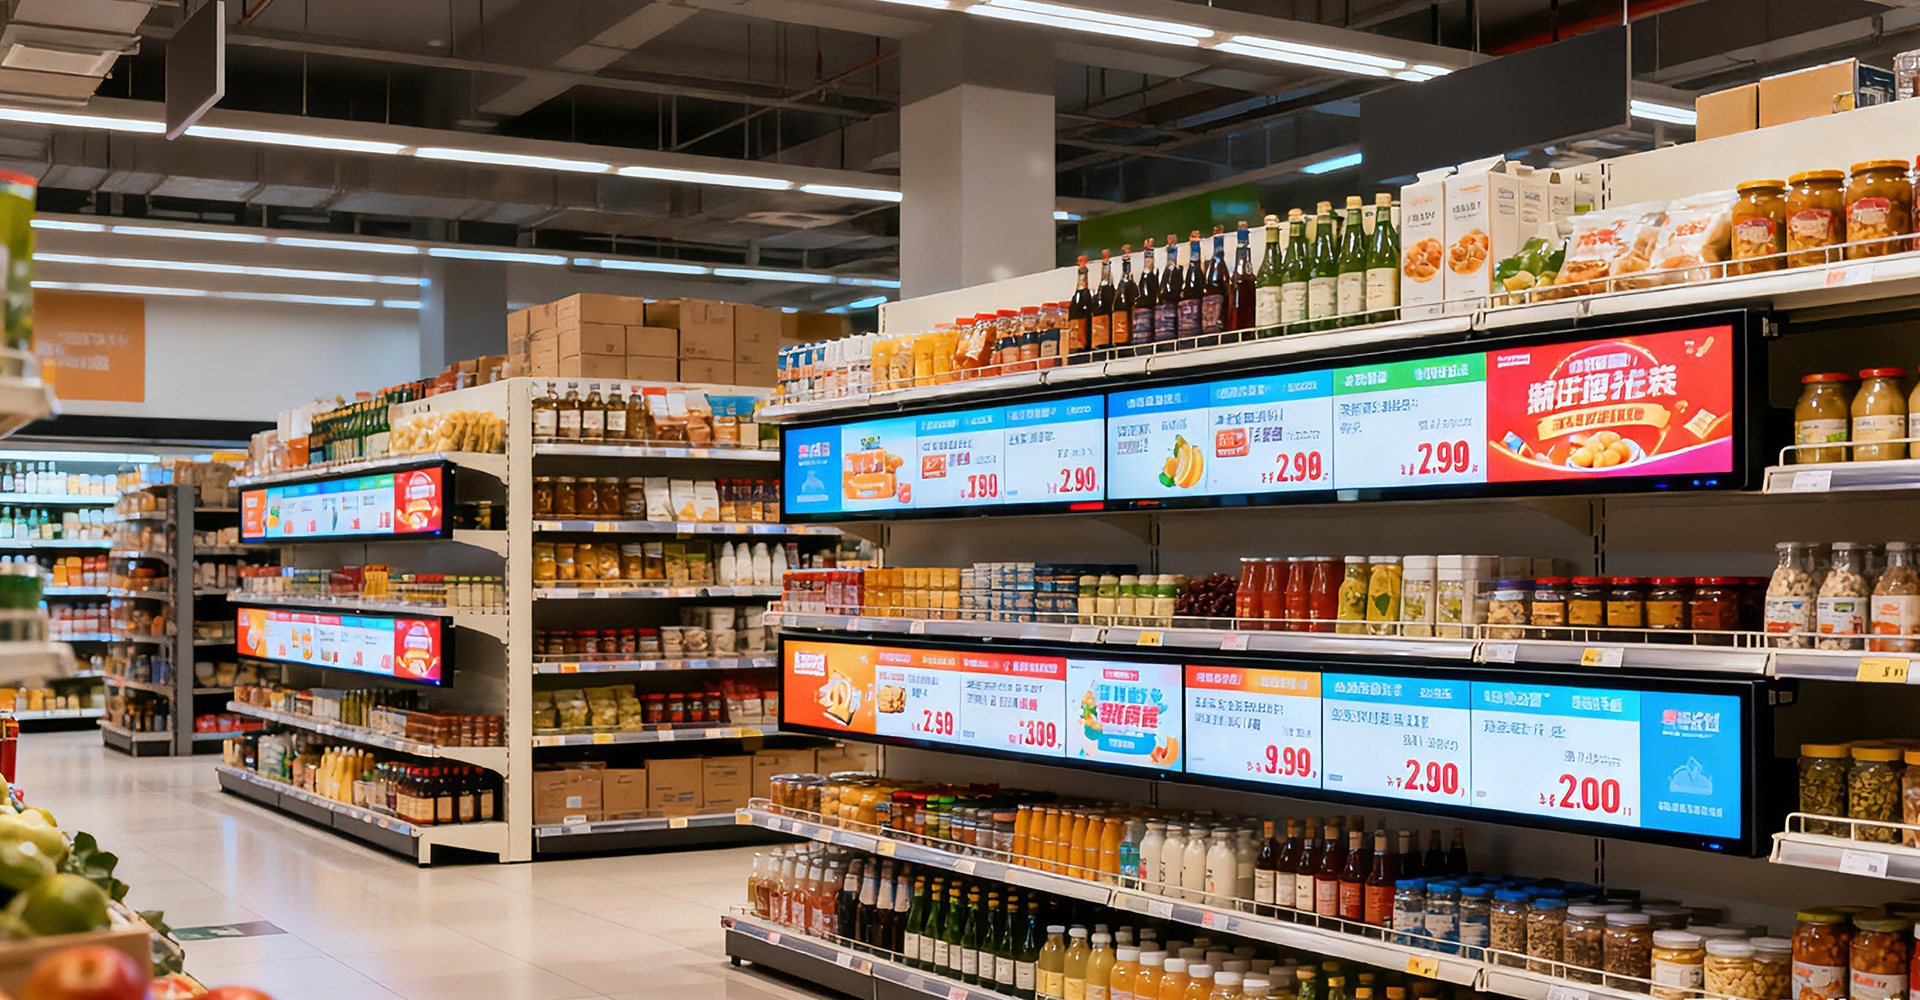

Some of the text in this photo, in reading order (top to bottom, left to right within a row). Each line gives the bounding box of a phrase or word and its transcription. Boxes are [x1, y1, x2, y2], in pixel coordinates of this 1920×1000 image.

[1277, 450, 1322, 482] 2.90
[1418, 440, 1469, 475] 2.90
[1060, 465, 1096, 493] 2.90
[1265, 744, 1311, 778] 9.90
[1405, 759, 1459, 795] 2.90
[1559, 773, 1620, 814] 2.00
